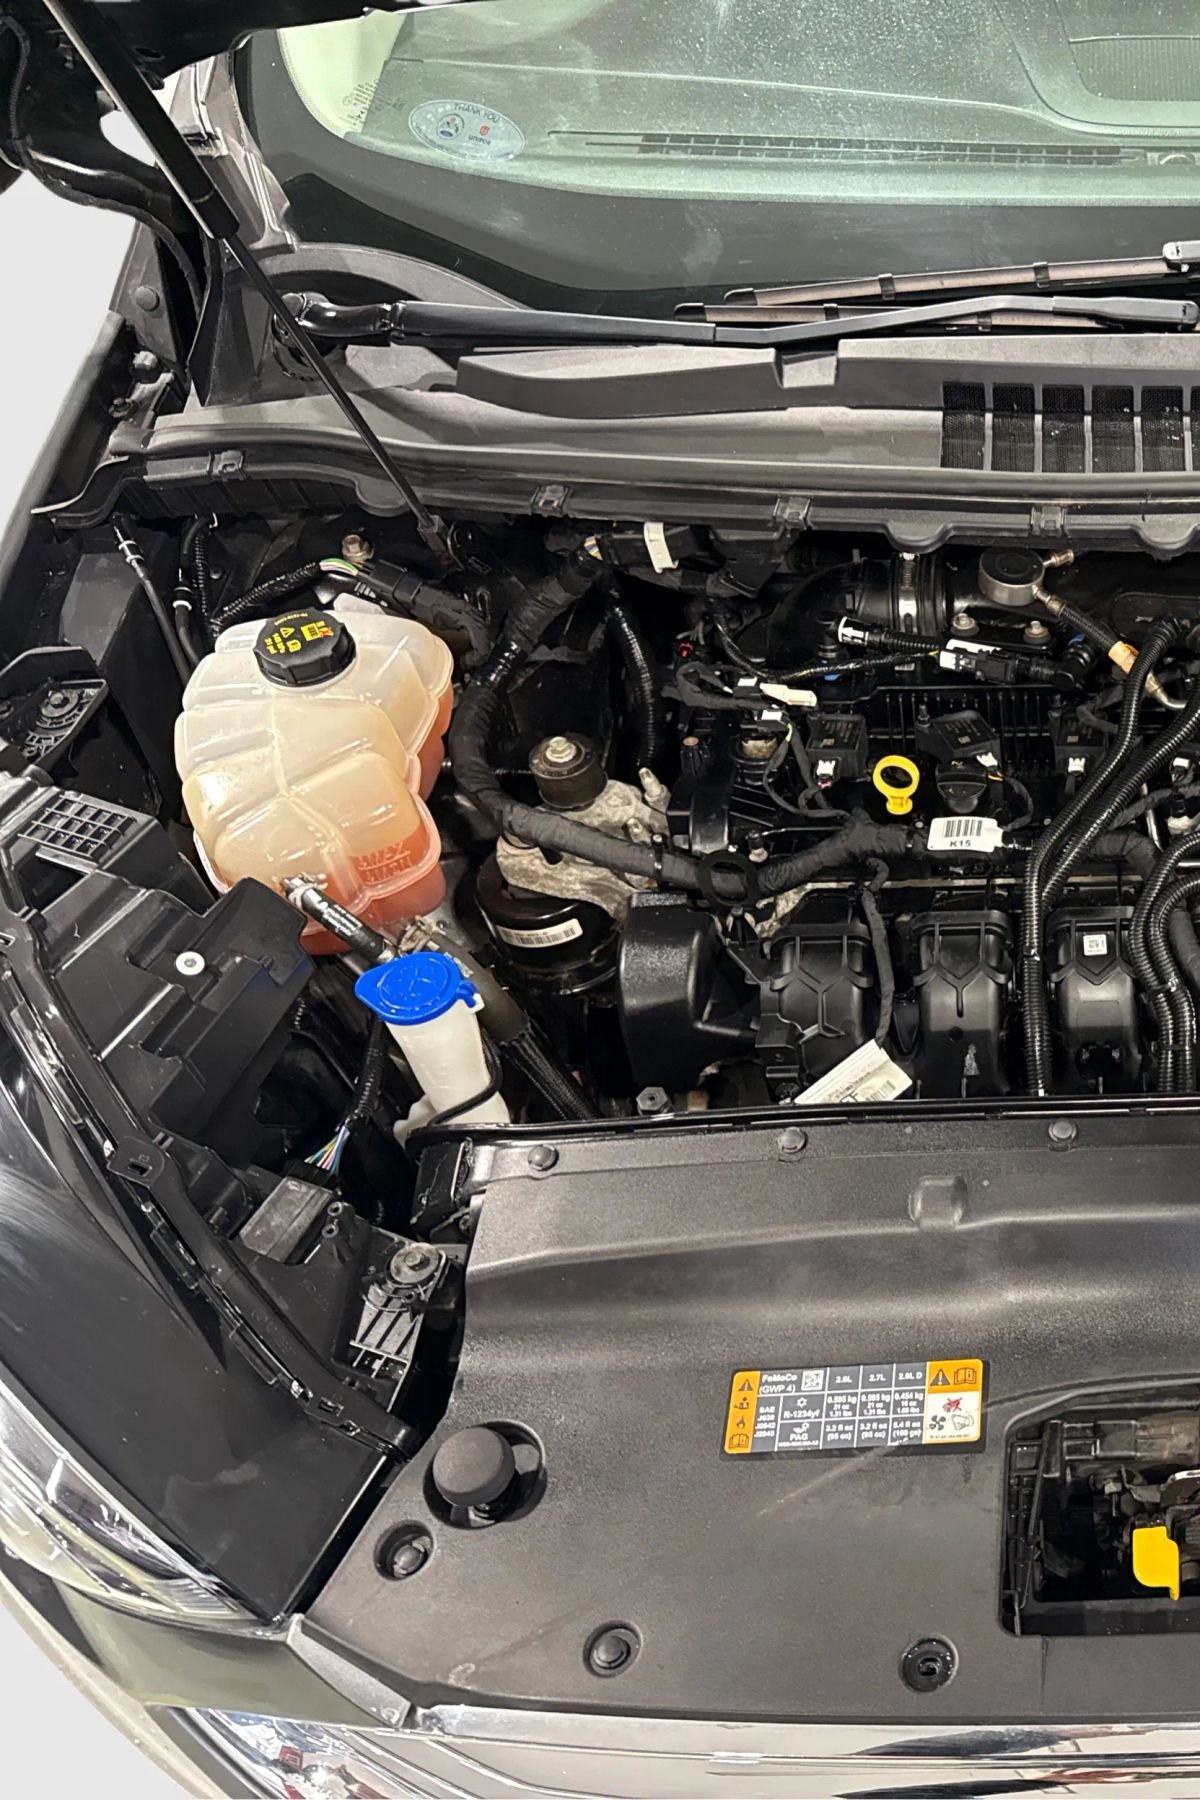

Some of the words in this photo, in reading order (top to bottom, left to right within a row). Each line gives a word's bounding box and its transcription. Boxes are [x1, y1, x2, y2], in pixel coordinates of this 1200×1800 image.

[454, 104, 481, 116] THANK
[484, 112, 500, 123] YOU
[950, 840, 972, 848] K15
[762, 1373, 798, 1382] FoMoCo
[868, 1374, 886, 1382] 2.7L
[759, 1384, 786, 1394] (GWP
[783, 1409, 820, 1419] R-1234yf
[790, 1433, 808, 1441] PAG
